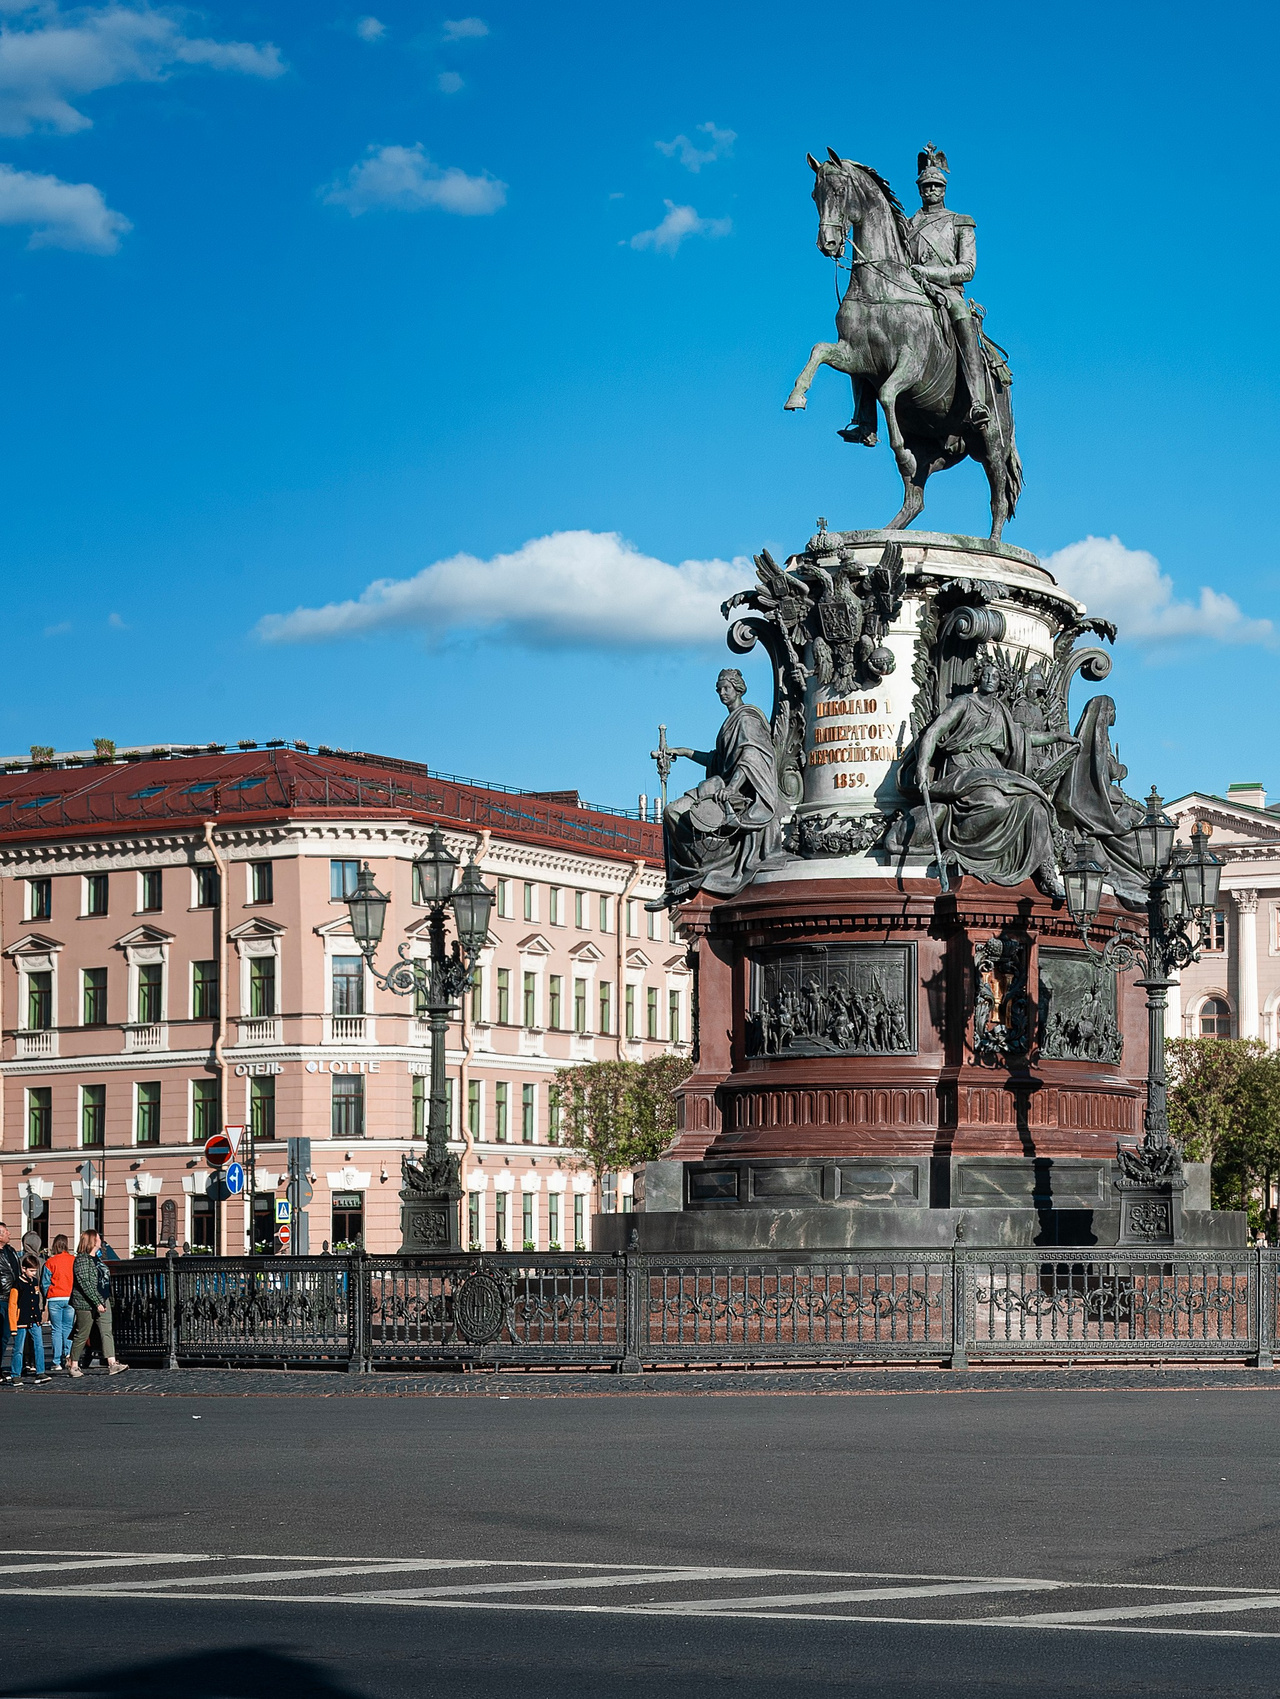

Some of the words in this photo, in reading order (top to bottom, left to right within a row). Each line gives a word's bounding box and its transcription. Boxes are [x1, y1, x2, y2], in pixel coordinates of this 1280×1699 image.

[235, 1061, 285, 1077] ОТЕЛЬ
[318, 1060, 381, 1074] LOTTE
[407, 1061, 432, 1076] HOTE
